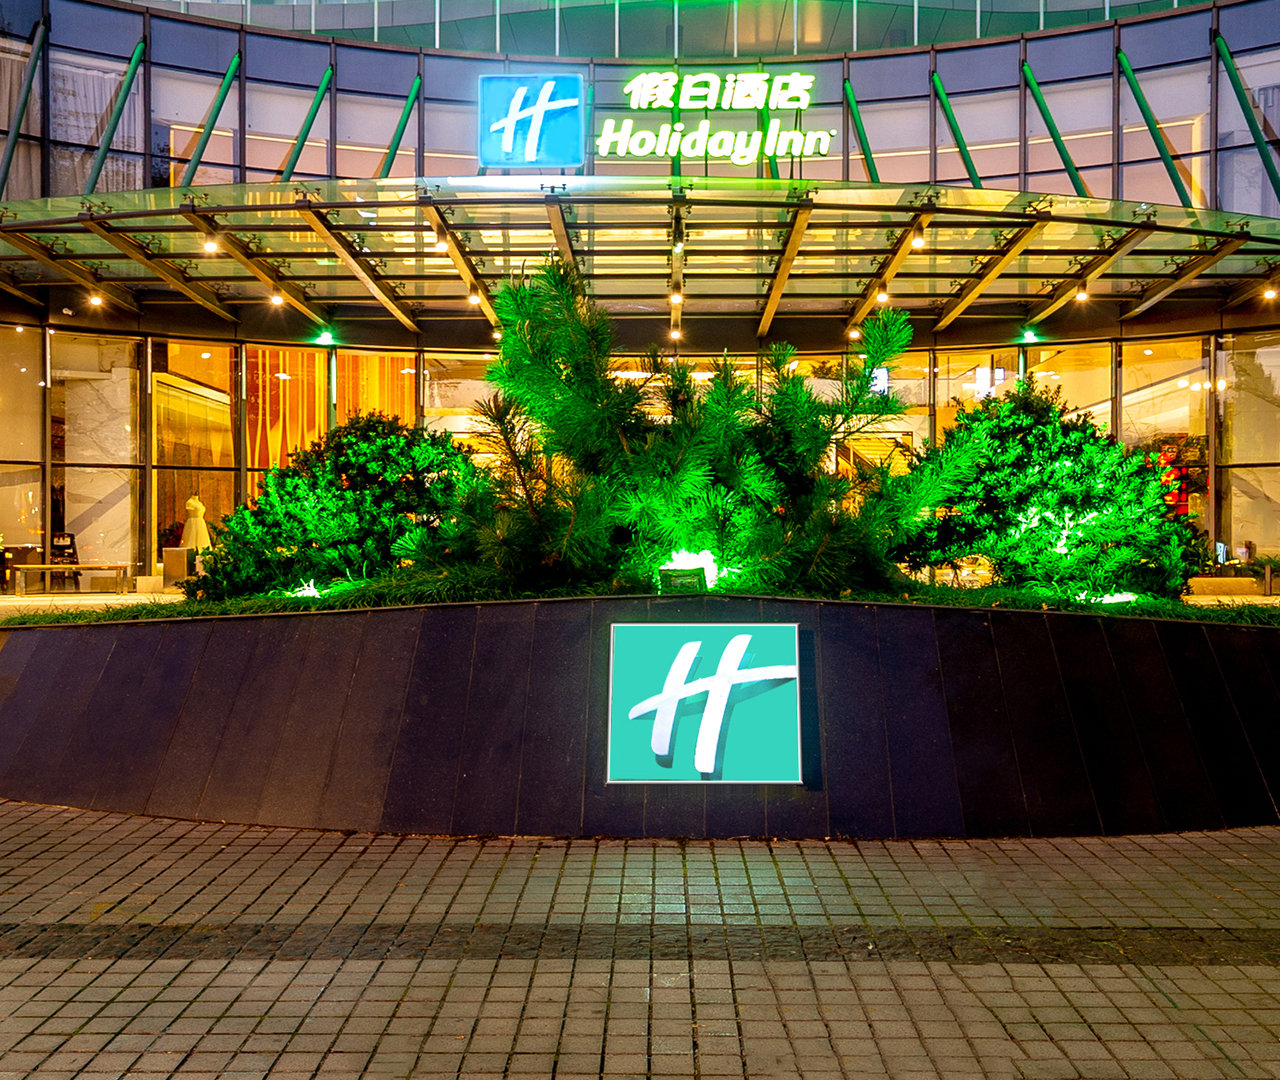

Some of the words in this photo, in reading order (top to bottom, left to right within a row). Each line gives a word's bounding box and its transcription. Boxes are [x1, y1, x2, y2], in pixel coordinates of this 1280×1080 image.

[490, 80, 578, 162] H
[623, 71, 815, 110] 假日酒店
[628, 634, 798, 773] H
